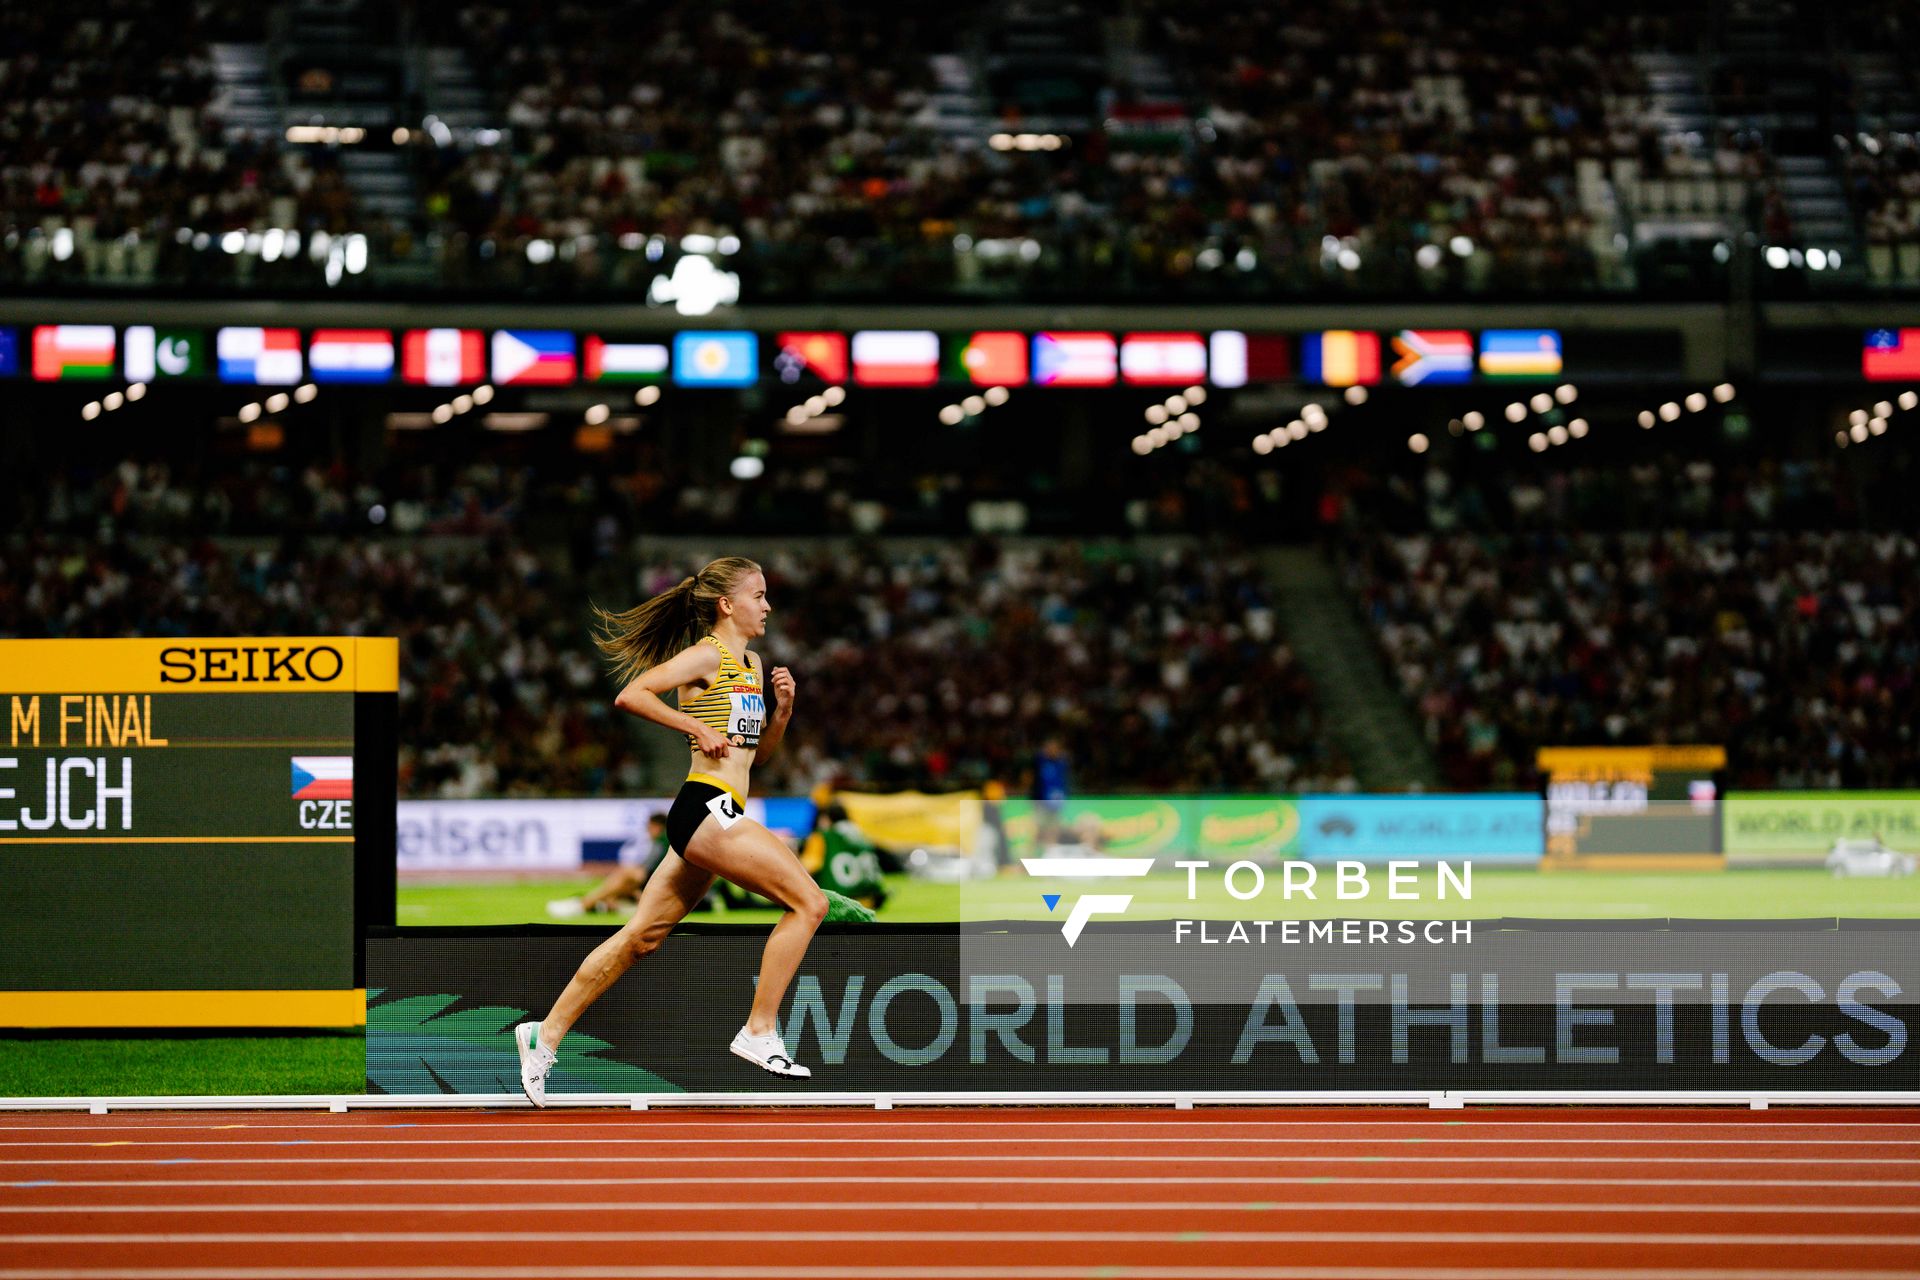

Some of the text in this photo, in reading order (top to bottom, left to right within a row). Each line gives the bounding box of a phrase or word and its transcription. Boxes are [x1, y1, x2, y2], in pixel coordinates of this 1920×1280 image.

[160, 646, 343, 683] SEIKO
[11, 695, 169, 748] M FINAL
[300, 800, 352, 829] CZE
[753, 971, 1908, 1066] WORLD ATHLETICS
